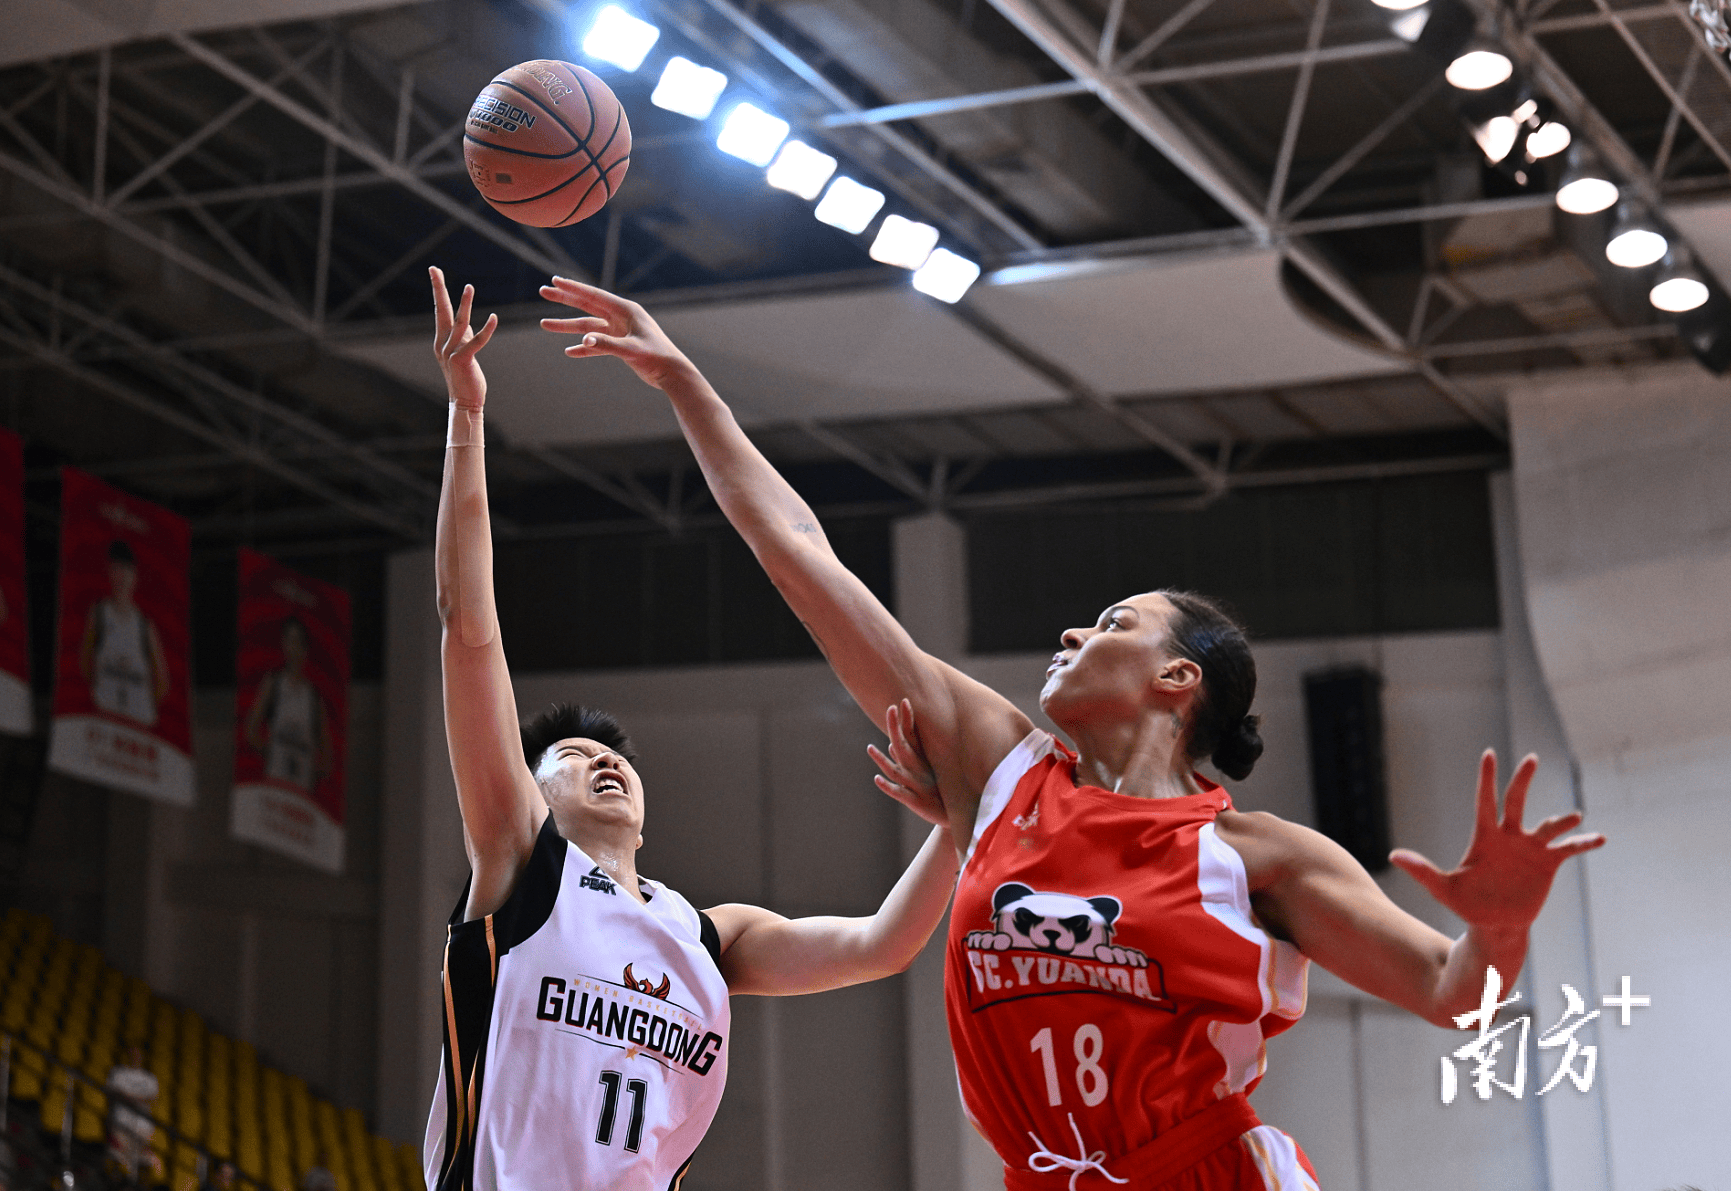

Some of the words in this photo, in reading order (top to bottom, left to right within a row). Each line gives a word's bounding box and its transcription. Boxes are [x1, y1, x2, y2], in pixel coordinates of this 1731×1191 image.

[475, 94, 537, 129] ECISION
[579, 874, 616, 896] PEAK
[536, 976, 723, 1076] GUANGDONG
[573, 978, 619, 998] WOMEN
[628, 995, 703, 1031] BASKETBALL
[1030, 1023, 1109, 1108] 18
[595, 1070, 647, 1154] 11
